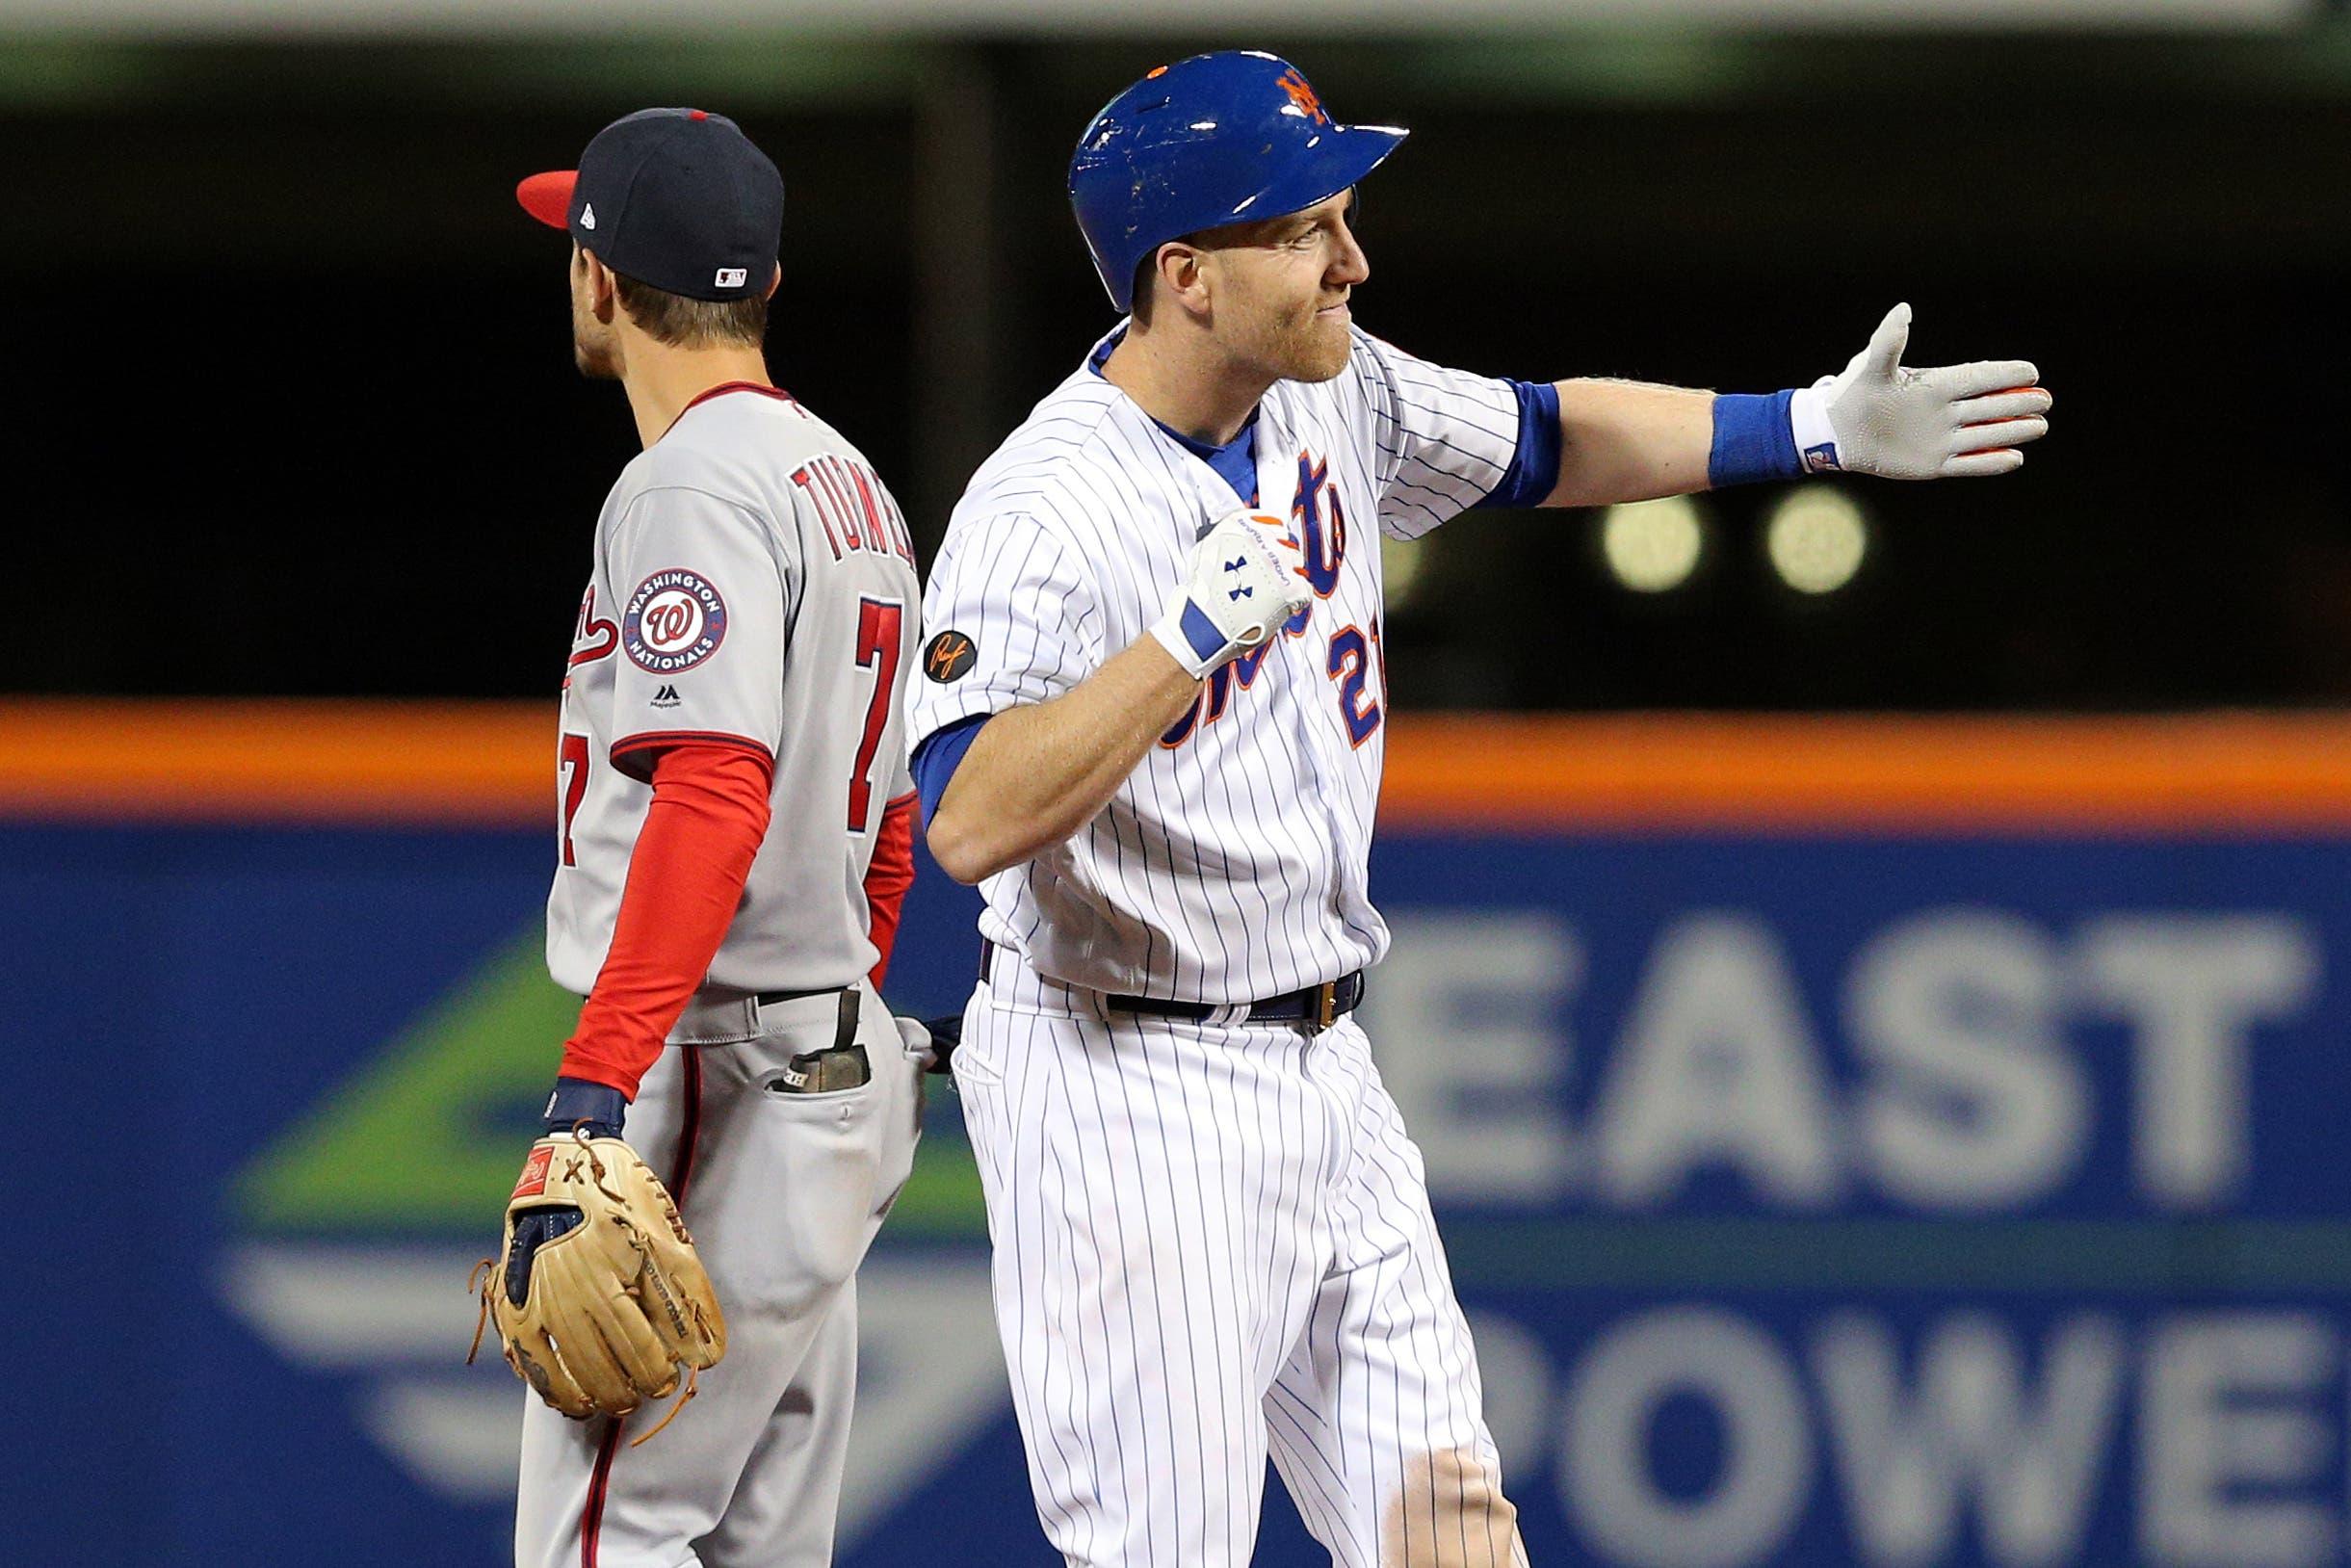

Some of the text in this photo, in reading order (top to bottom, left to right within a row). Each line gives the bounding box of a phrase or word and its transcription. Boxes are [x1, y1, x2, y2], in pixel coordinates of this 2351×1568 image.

[628, 573, 720, 614] WASHINGTON
[646, 598, 693, 645] W
[629, 637, 714, 669] NATIONALS
[848, 595, 903, 834] 7
[561, 734, 589, 867] 7
[1360, 908, 2312, 1212] EAST
